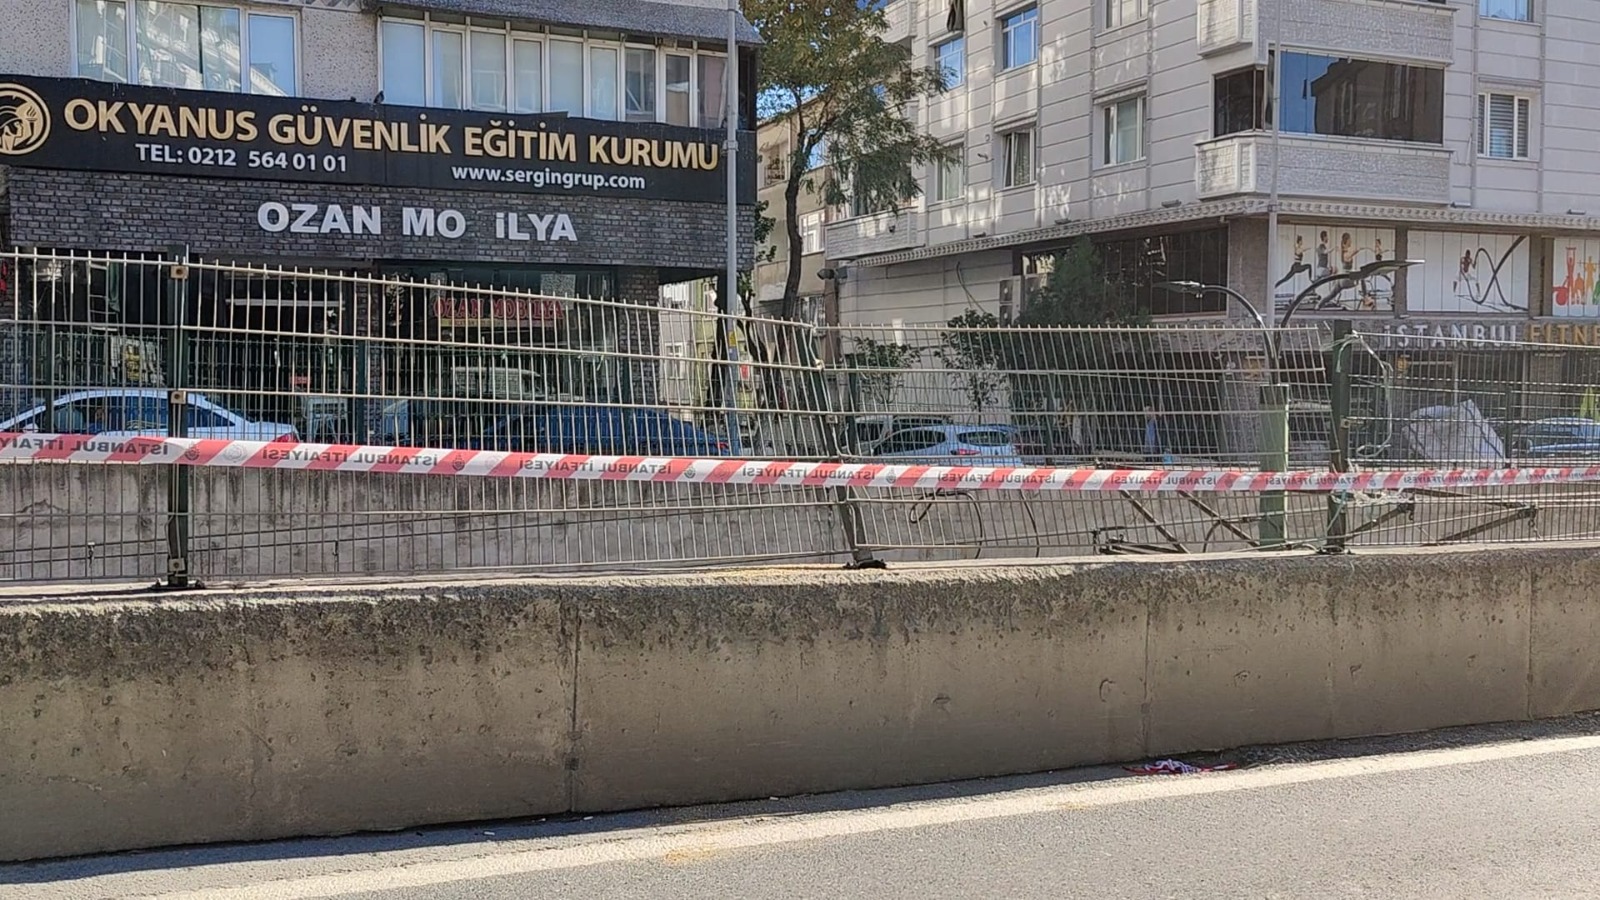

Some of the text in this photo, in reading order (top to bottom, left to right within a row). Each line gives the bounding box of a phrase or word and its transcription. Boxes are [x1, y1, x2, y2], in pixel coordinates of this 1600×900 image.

[64, 98, 719, 171] OKYANUS GÜVENLİK EĞİTİM KURUMU
[136, 143, 347, 172] TEL: 0212 564 01 01
[451, 165, 646, 190] www.sergingrup.com
[257, 201, 382, 235] OZAN
[401, 207, 467, 239] MO
[433, 296, 485, 318] OZAN
